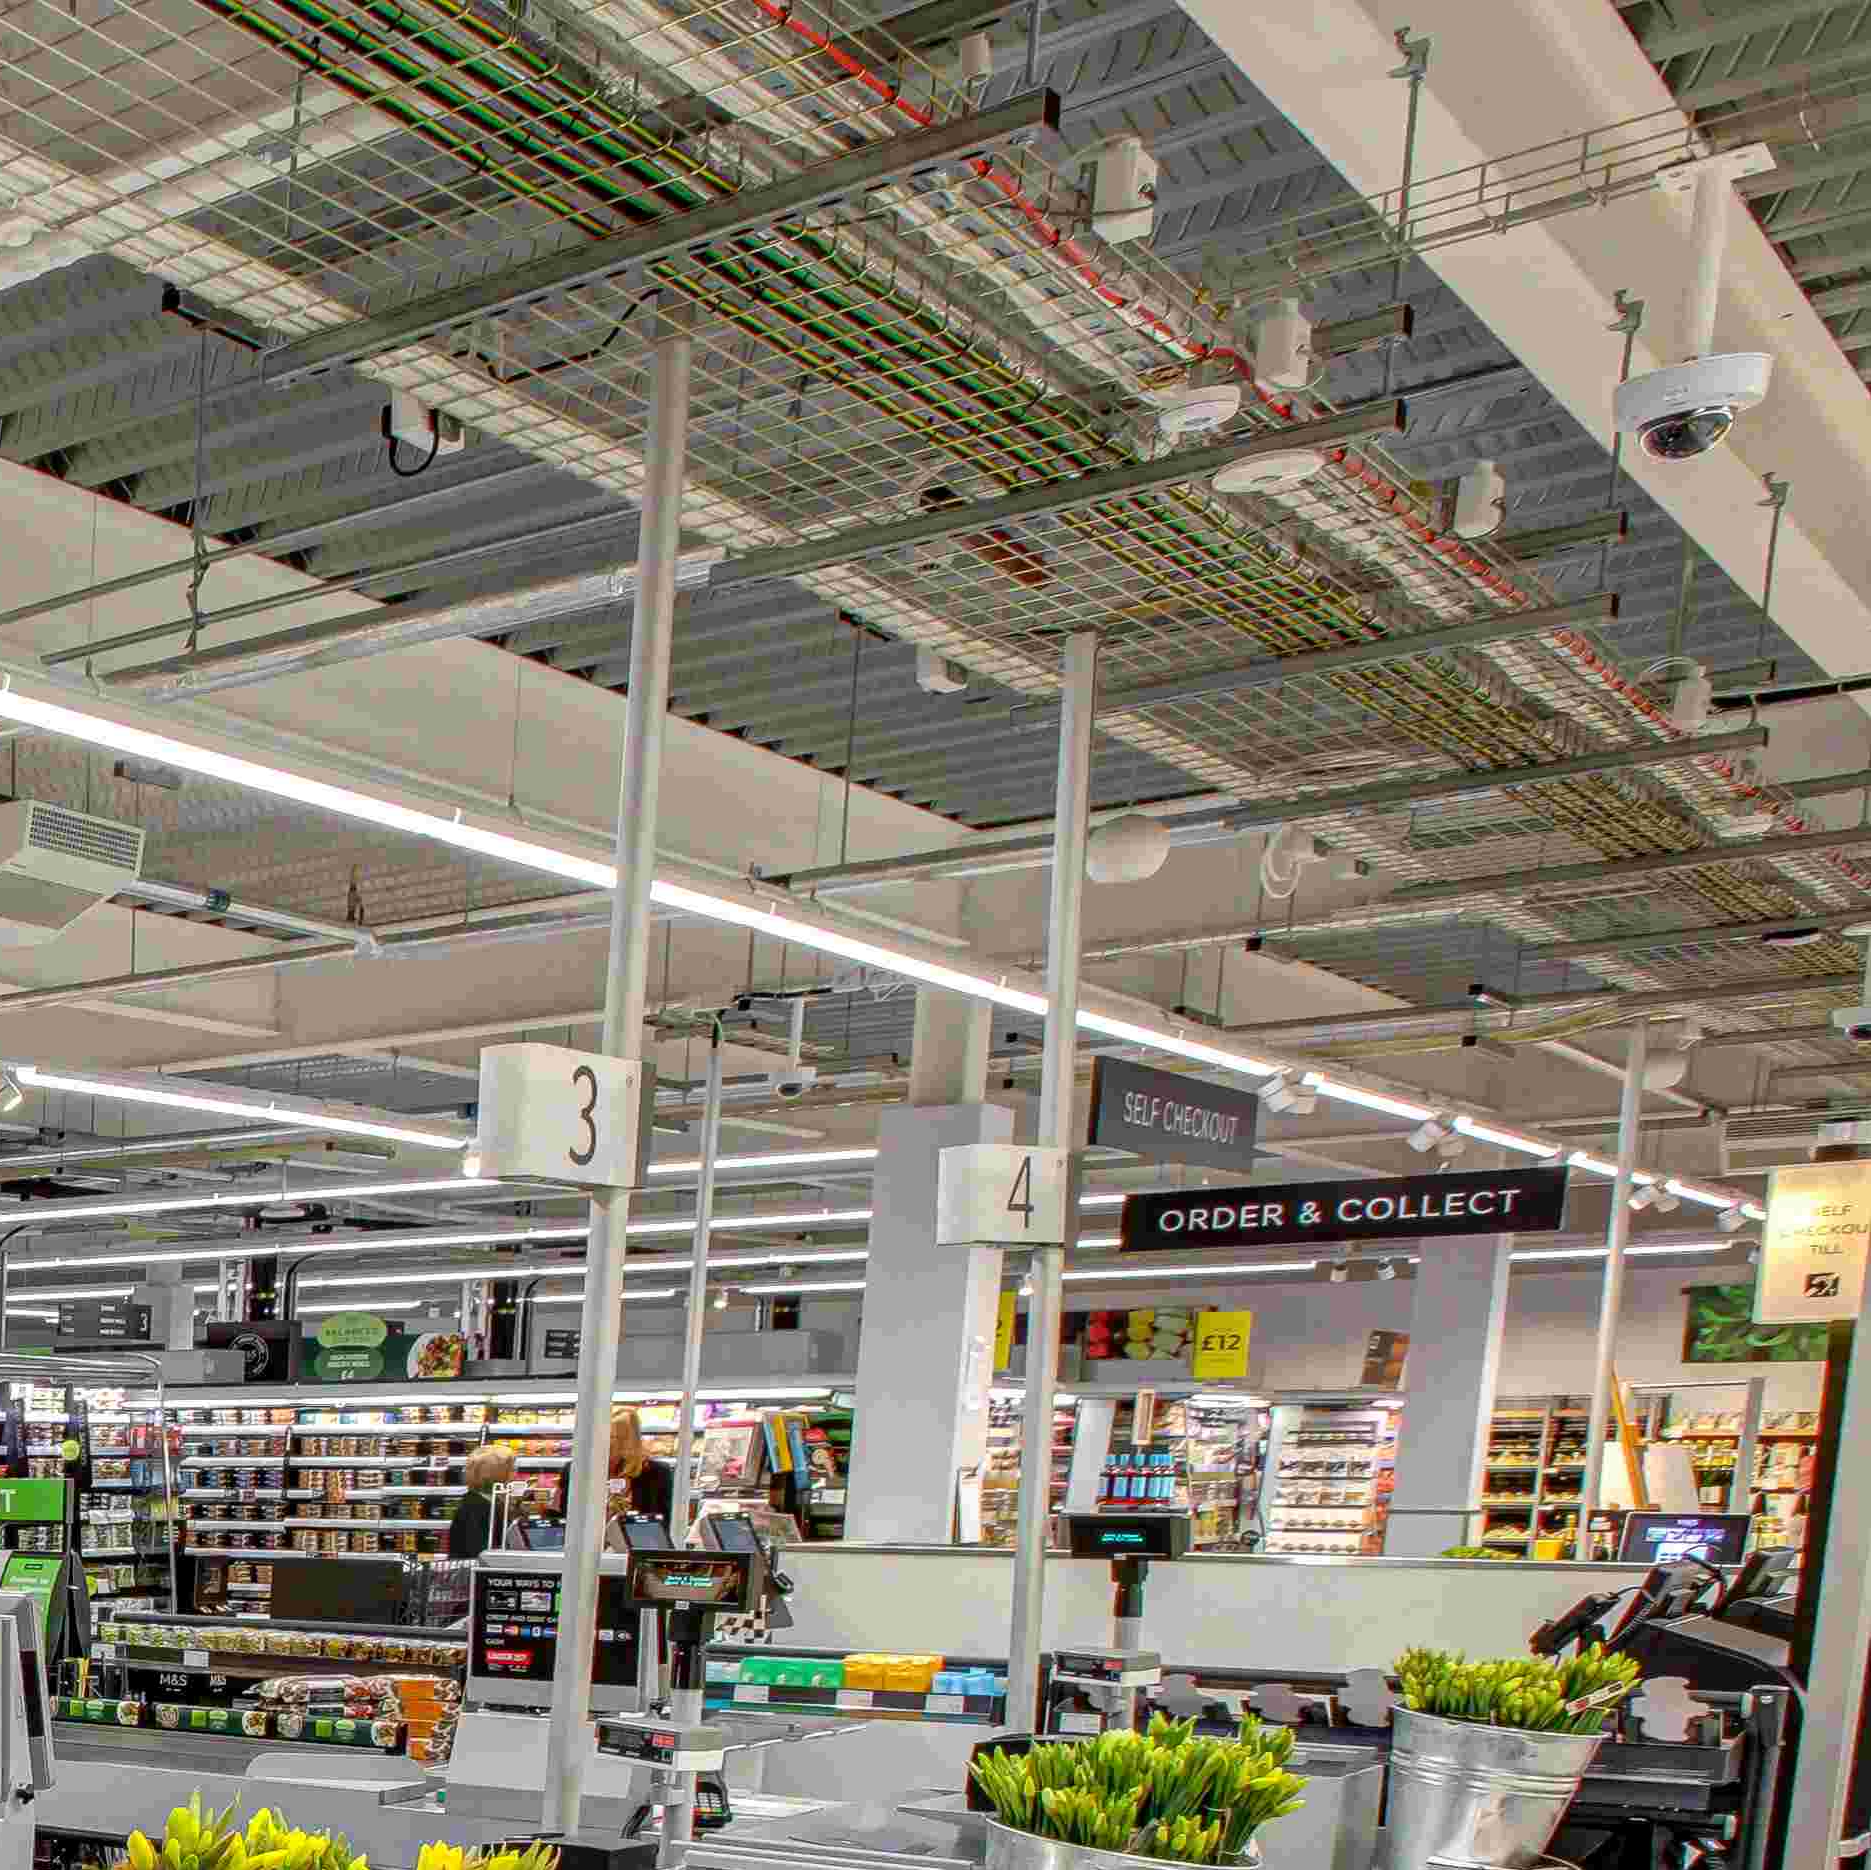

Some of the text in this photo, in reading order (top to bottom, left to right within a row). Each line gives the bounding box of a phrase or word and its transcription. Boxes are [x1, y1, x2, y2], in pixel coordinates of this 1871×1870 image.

[570, 1066, 597, 1165] 3
[1124, 1092, 1239, 1144] SELF CHECKOUT
[1008, 1156, 1032, 1228] 4
[1159, 1190, 1521, 1231] ORDER & COLLECT
[1202, 1335, 1241, 1351] £12
[488, 1578, 513, 1588] YOUR
[159, 1673, 187, 1686] M&S
